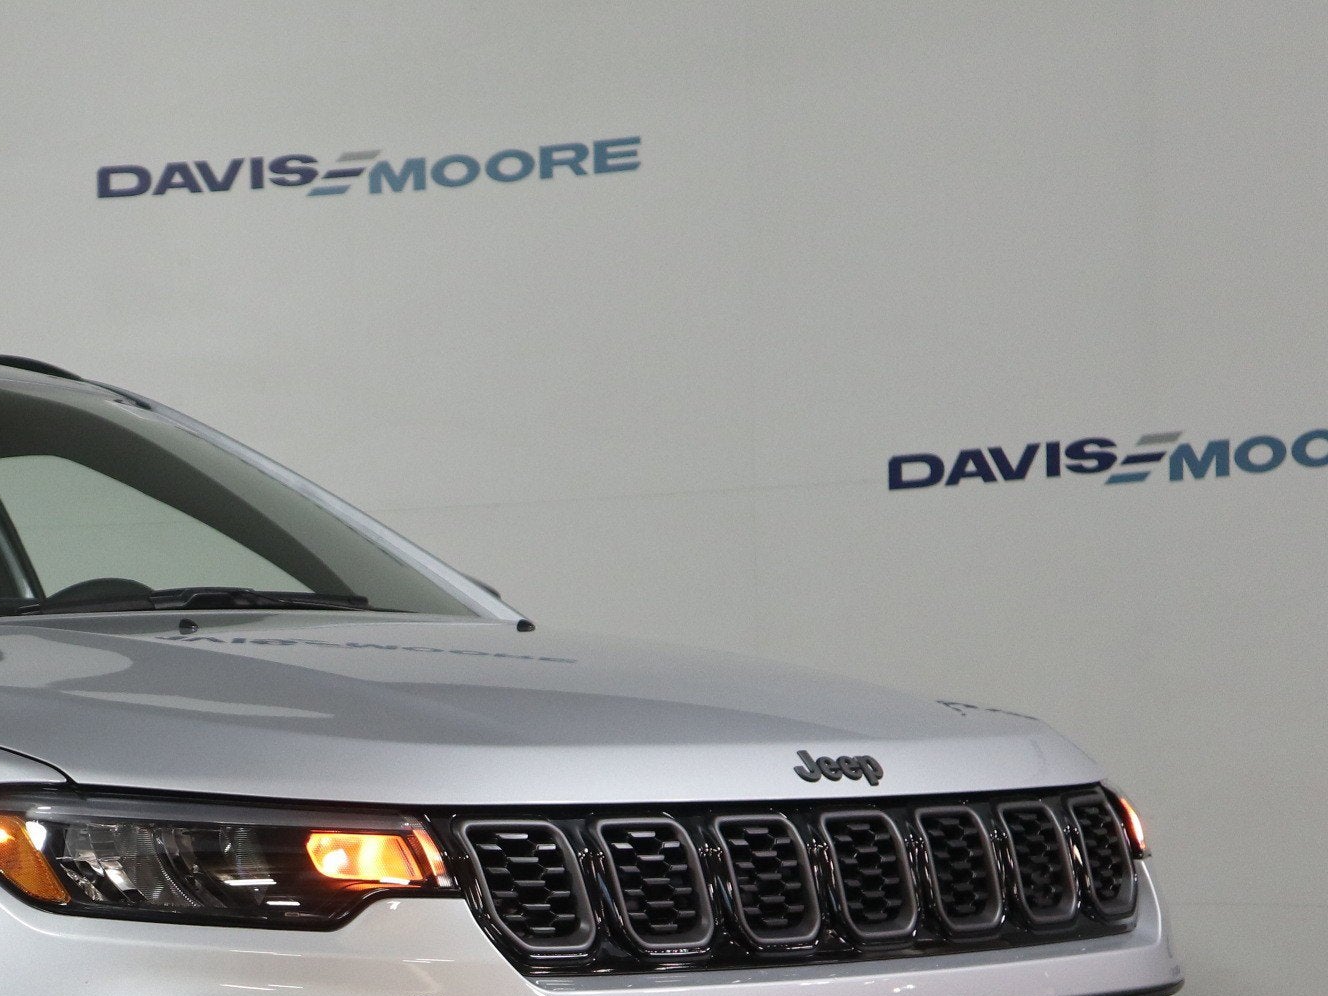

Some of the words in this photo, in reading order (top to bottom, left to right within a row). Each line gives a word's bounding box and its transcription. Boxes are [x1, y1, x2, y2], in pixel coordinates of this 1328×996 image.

[96, 154, 318, 198] DAVIS
[369, 136, 642, 194] MOORE
[888, 437, 1118, 490] DAVIS
[793, 750, 884, 786] Jeep
